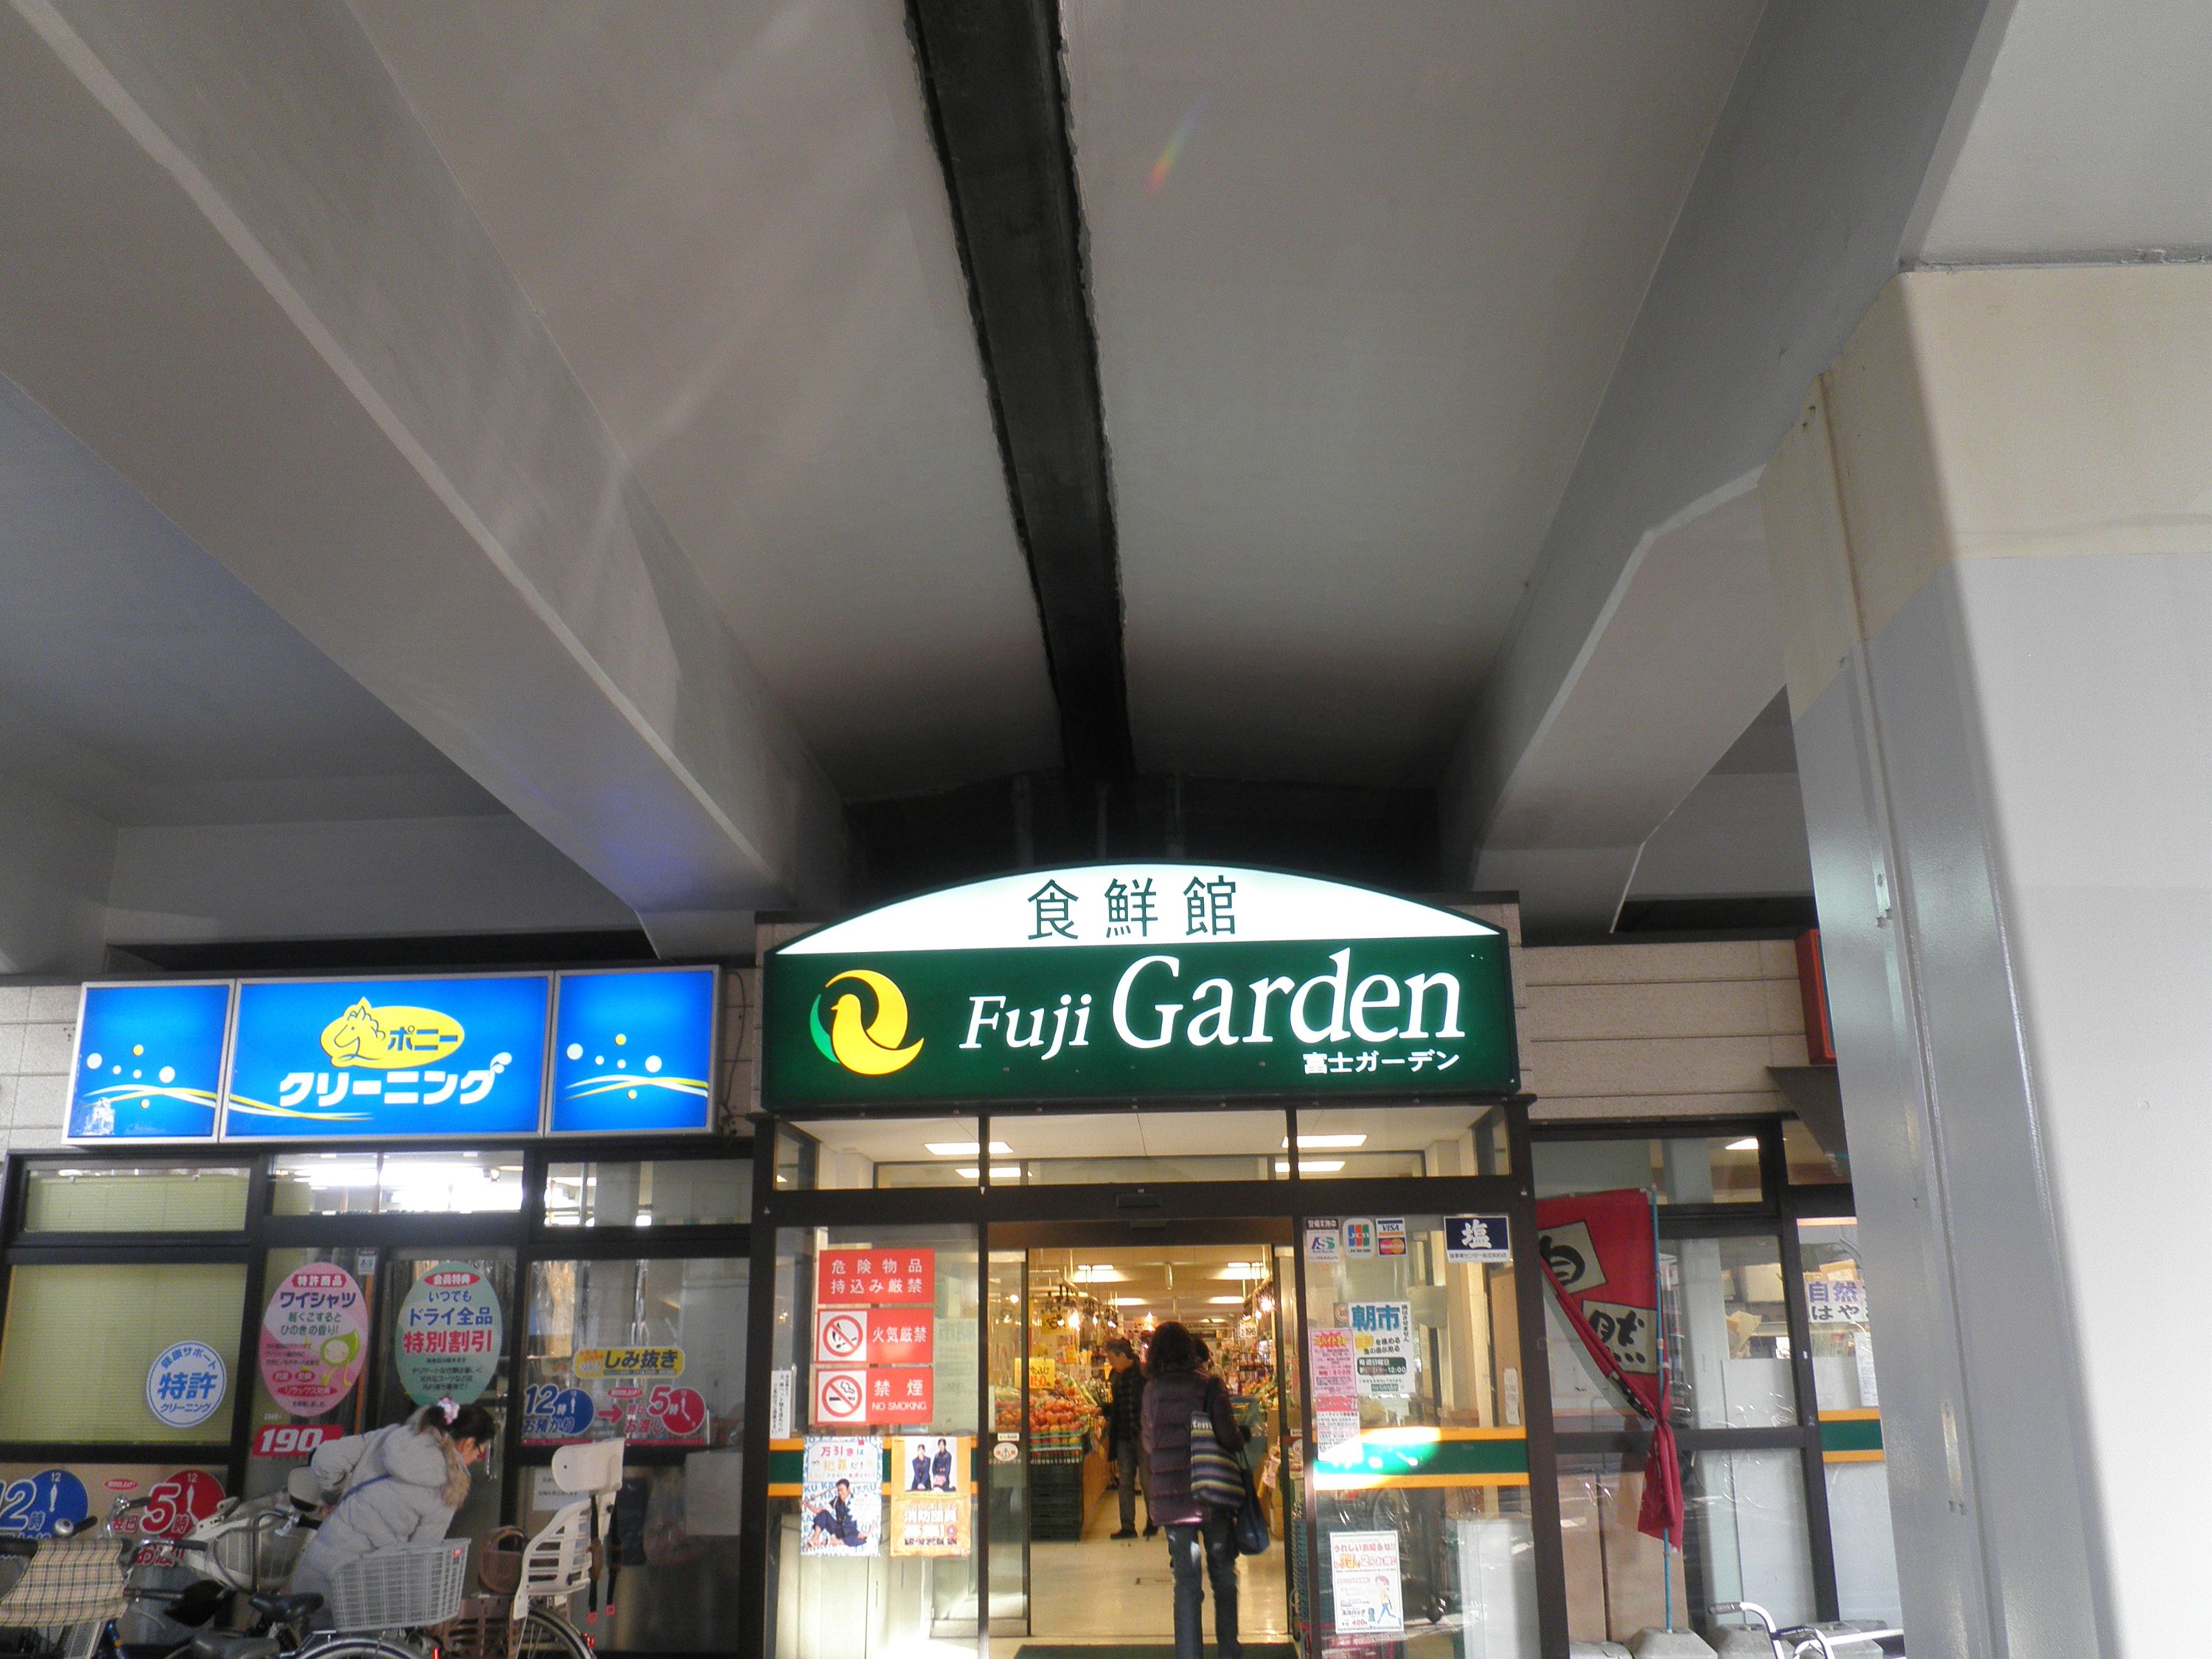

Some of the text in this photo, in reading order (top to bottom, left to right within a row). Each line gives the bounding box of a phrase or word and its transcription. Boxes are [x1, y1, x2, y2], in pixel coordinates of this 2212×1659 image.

[1027, 874, 1237, 940] 食鮮館
[959, 947, 1466, 1061] Fuji Garden
[387, 1026, 459, 1051] ポニー
[1302, 1049, 1460, 1075] 富士ガーデン
[279, 1068, 496, 1107] クリーニング
[1461, 1219, 1492, 1249] 塩
[831, 1258, 922, 1275] 危険物品
[830, 1278, 922, 1294] 持込み厳禁
[280, 1292, 356, 1309] ワイシャツ
[428, 1290, 472, 1303] いつでも
[410, 1307, 493, 1326] ドライ全品
[1352, 1304, 1401, 1332] 朝市
[403, 1329, 493, 1354] 特別割引
[872, 1326, 927, 1343] 火気厳禁
[605, 1350, 678, 1369] しみ抜き
[157, 1371, 218, 1399] 特許
[874, 1380, 923, 1397] 禁煙
[159, 1403, 212, 1413] クリーニング
[872, 1401, 927, 1411] NO SMOKING
[260, 1428, 323, 1453] 190
[820, 1446, 864, 1458] 万引きは
[52, 1472, 61, 1482] 12
[187, 1472, 198, 1482] 12
